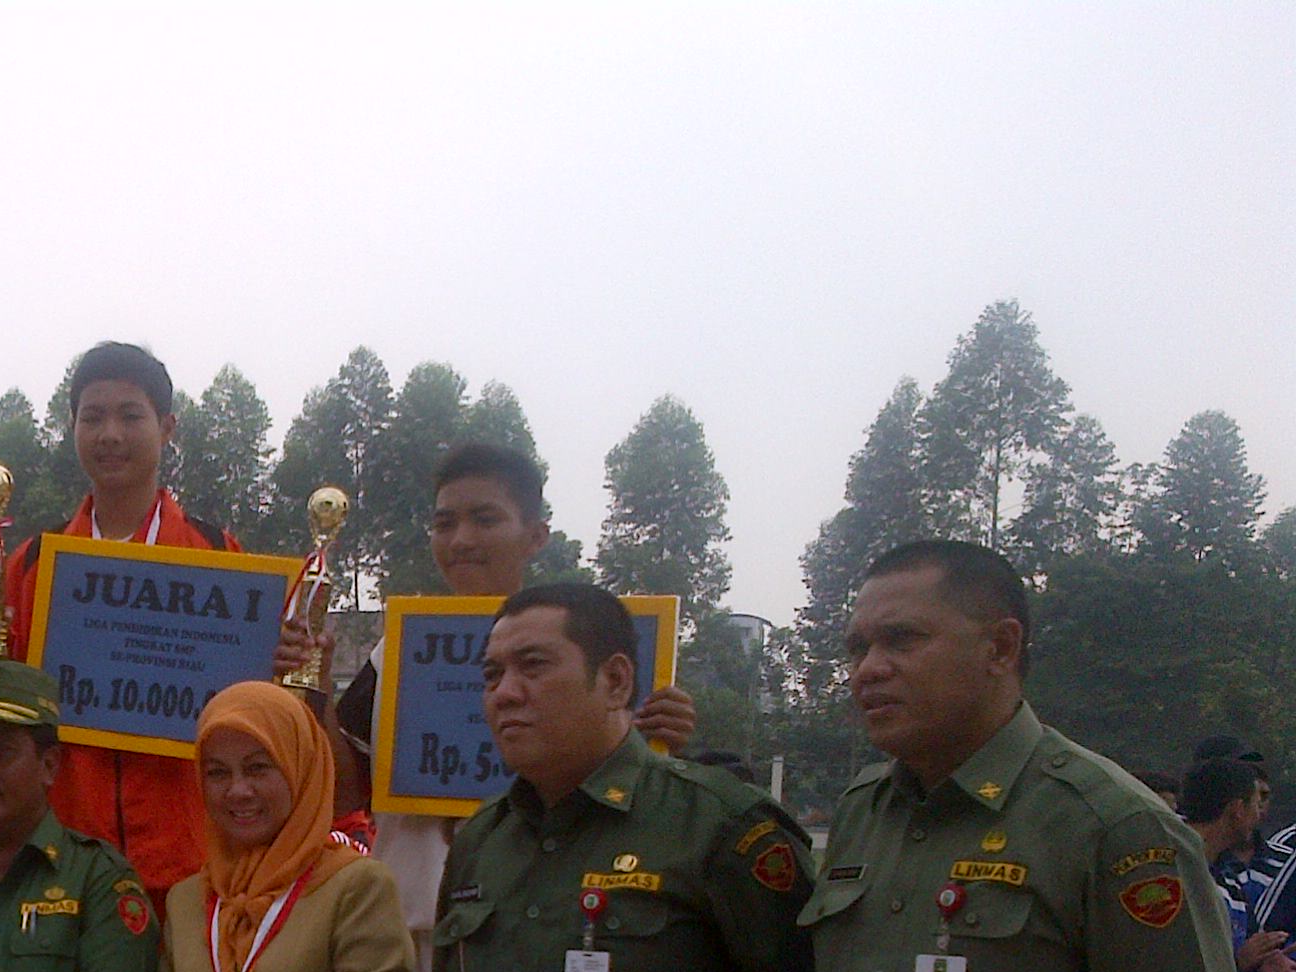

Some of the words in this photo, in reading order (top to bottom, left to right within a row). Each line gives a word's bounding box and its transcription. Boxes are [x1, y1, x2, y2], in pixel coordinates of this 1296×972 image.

[73, 573, 233, 620] JUARA
[244, 589, 264, 623] I
[85, 619, 108, 630] LIGA
[111, 622, 179, 638] PENDIDIKAN
[182, 630, 241, 646] INDONESIA
[125, 639, 173, 653] TINGKAT
[60, 665, 100, 716] Rp.
[419, 732, 466, 785] Rp.
[586, 874, 653, 888] LINMAS
[954, 862, 1022, 881] LINMAS
